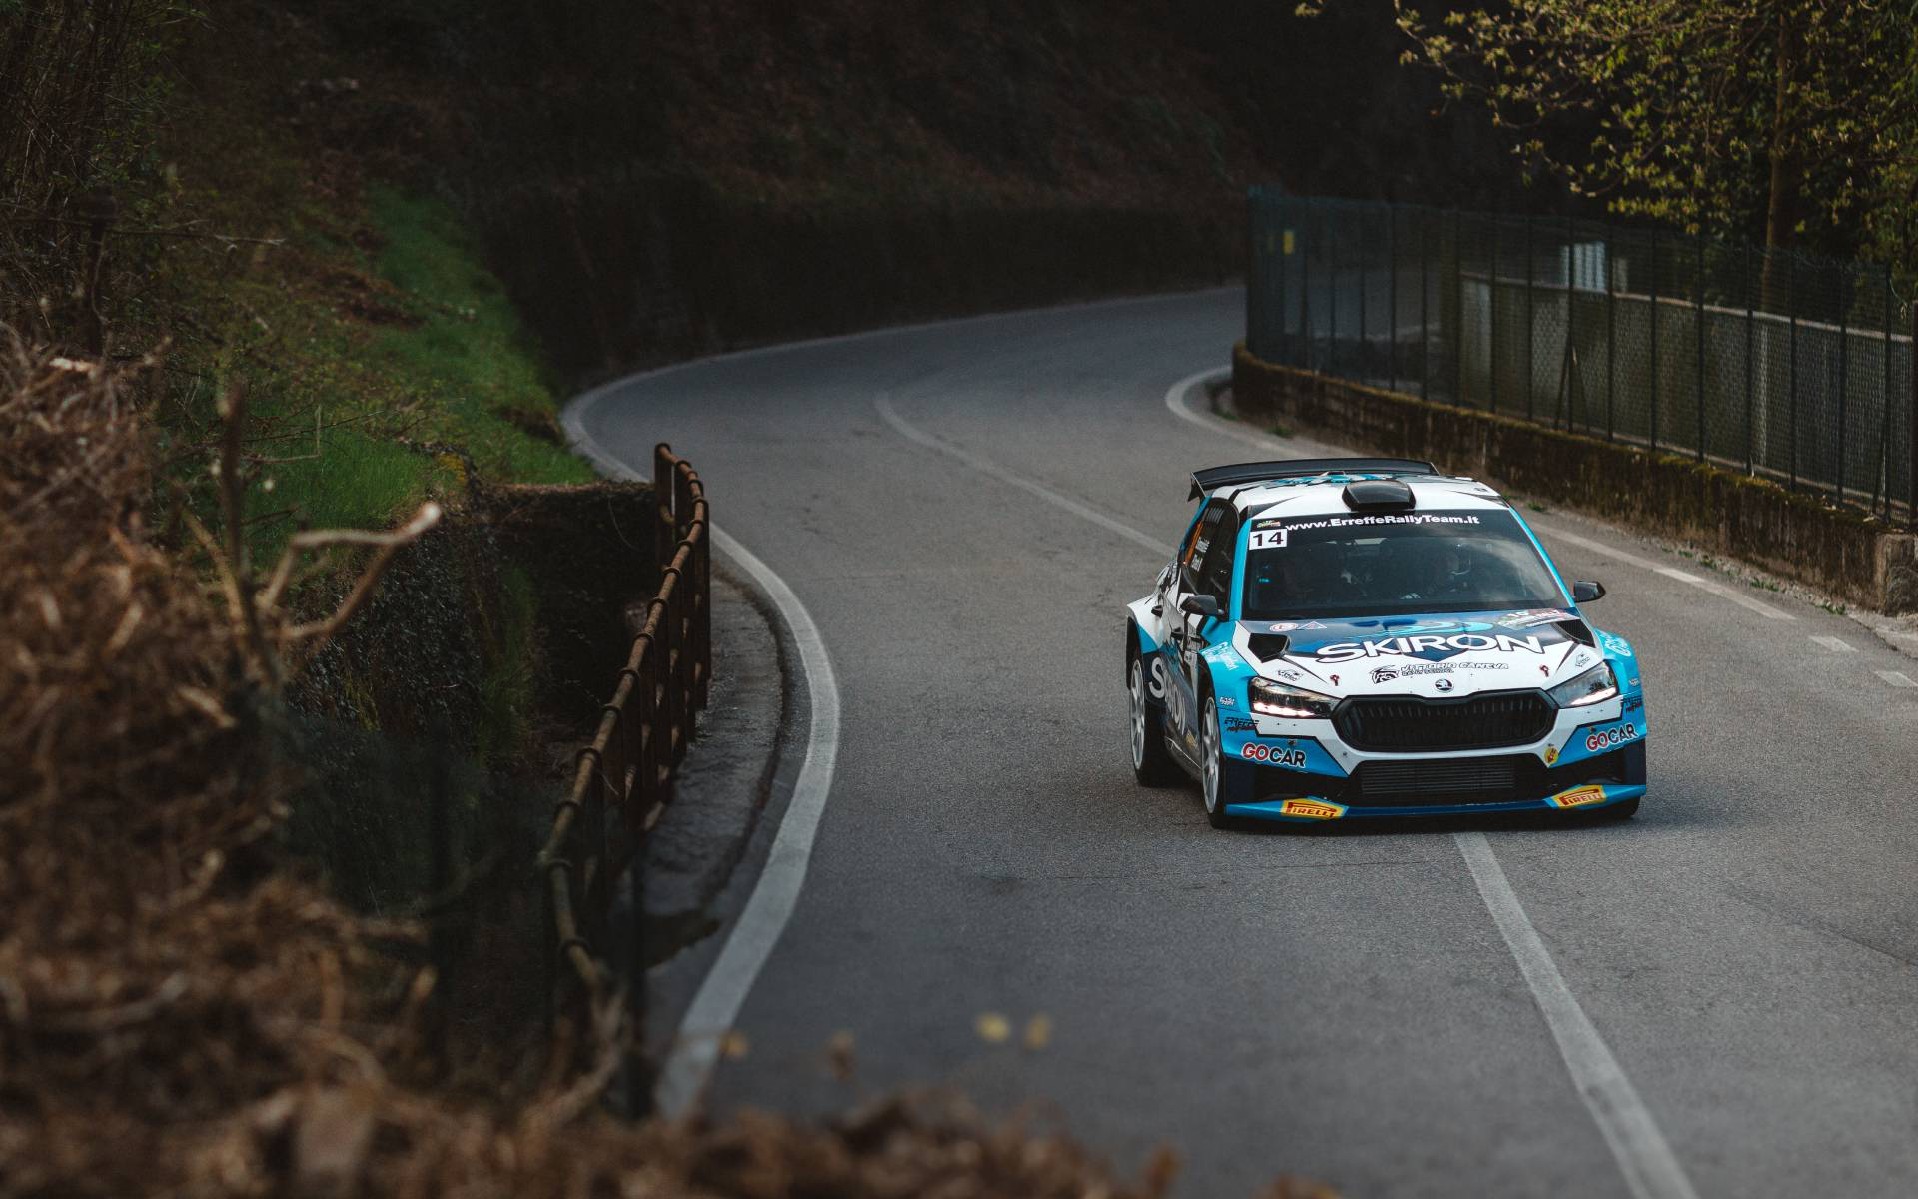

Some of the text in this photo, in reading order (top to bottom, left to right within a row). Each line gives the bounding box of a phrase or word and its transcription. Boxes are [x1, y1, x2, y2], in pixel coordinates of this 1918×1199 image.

[1285, 514, 1480, 532] www.ErreffeRallyTeam.it
[1252, 531, 1285, 548] 14
[1314, 633, 1546, 664] SKIRON
[1585, 722, 1639, 752] GOCAR
[1242, 743, 1307, 769] GOCAR
[1558, 787, 1604, 806] PIRELLI
[1286, 801, 1338, 818] PIRELLI
